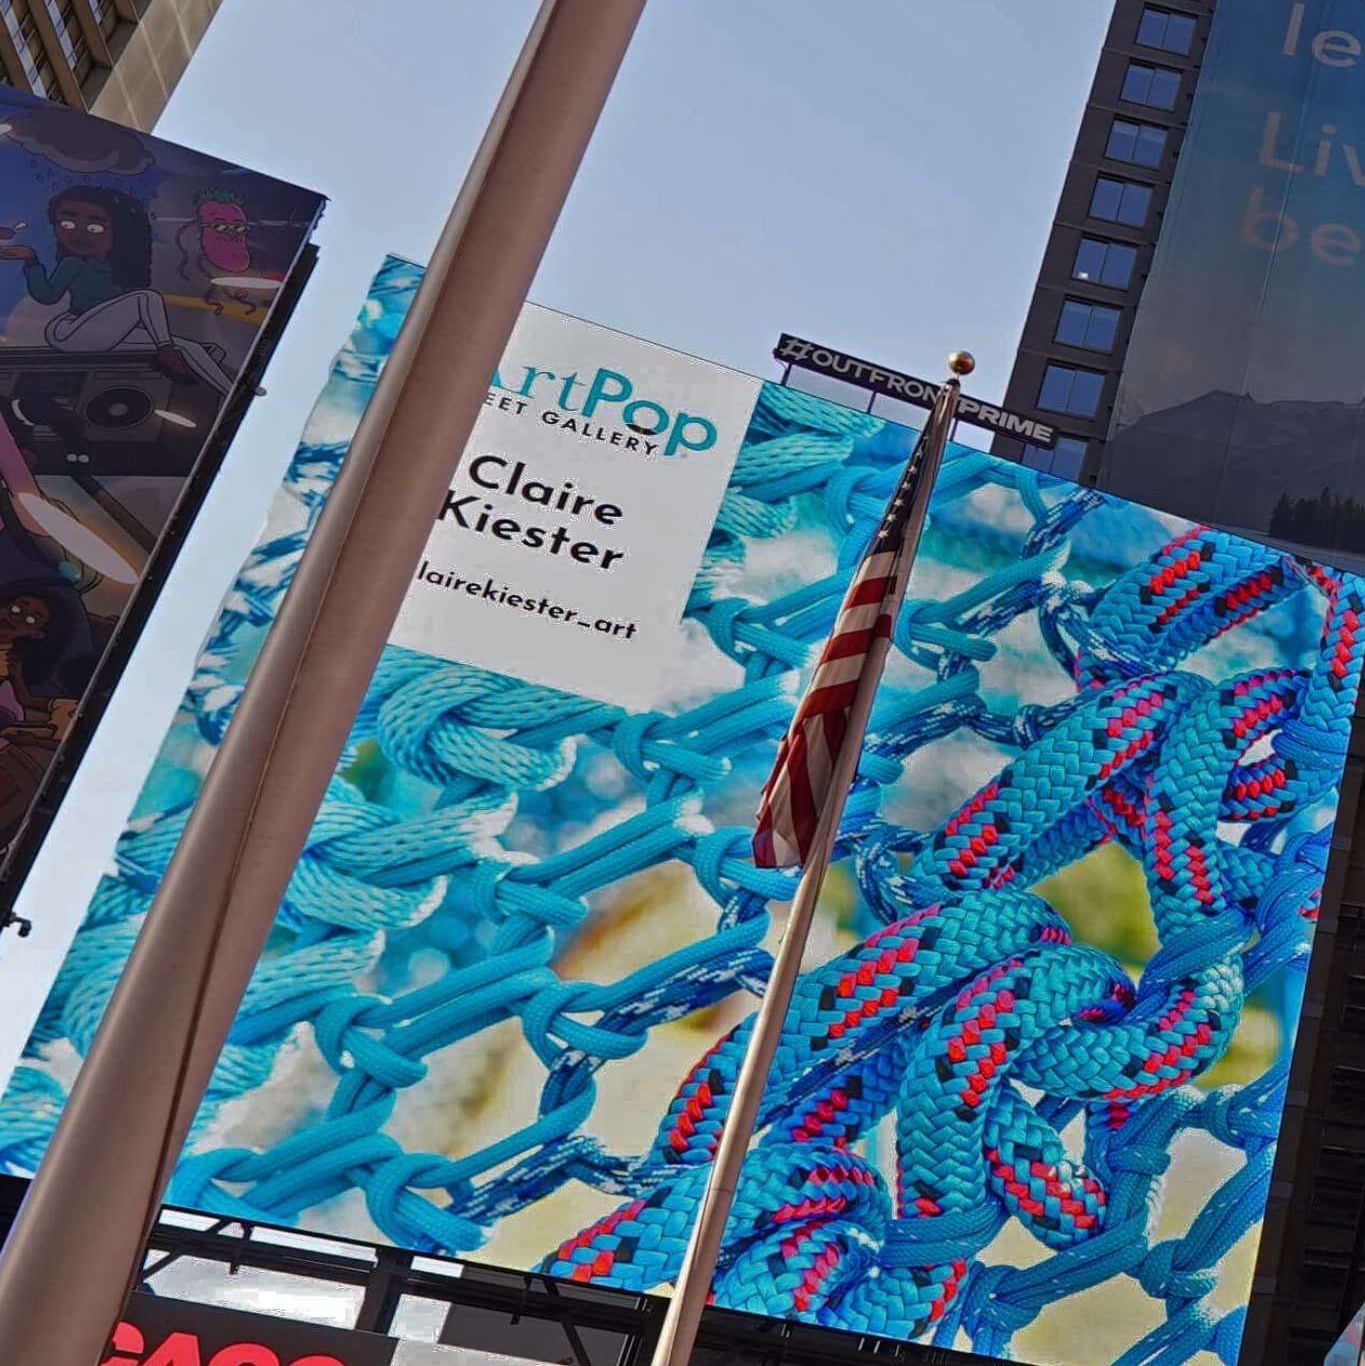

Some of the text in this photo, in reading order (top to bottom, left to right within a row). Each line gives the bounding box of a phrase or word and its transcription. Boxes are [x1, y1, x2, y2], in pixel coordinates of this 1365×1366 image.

[541, 411, 658, 456] GALLERY
[469, 455, 623, 525] Claire
[437, 489, 624, 569] Kiester
[416, 560, 638, 640] lairekiester_art
